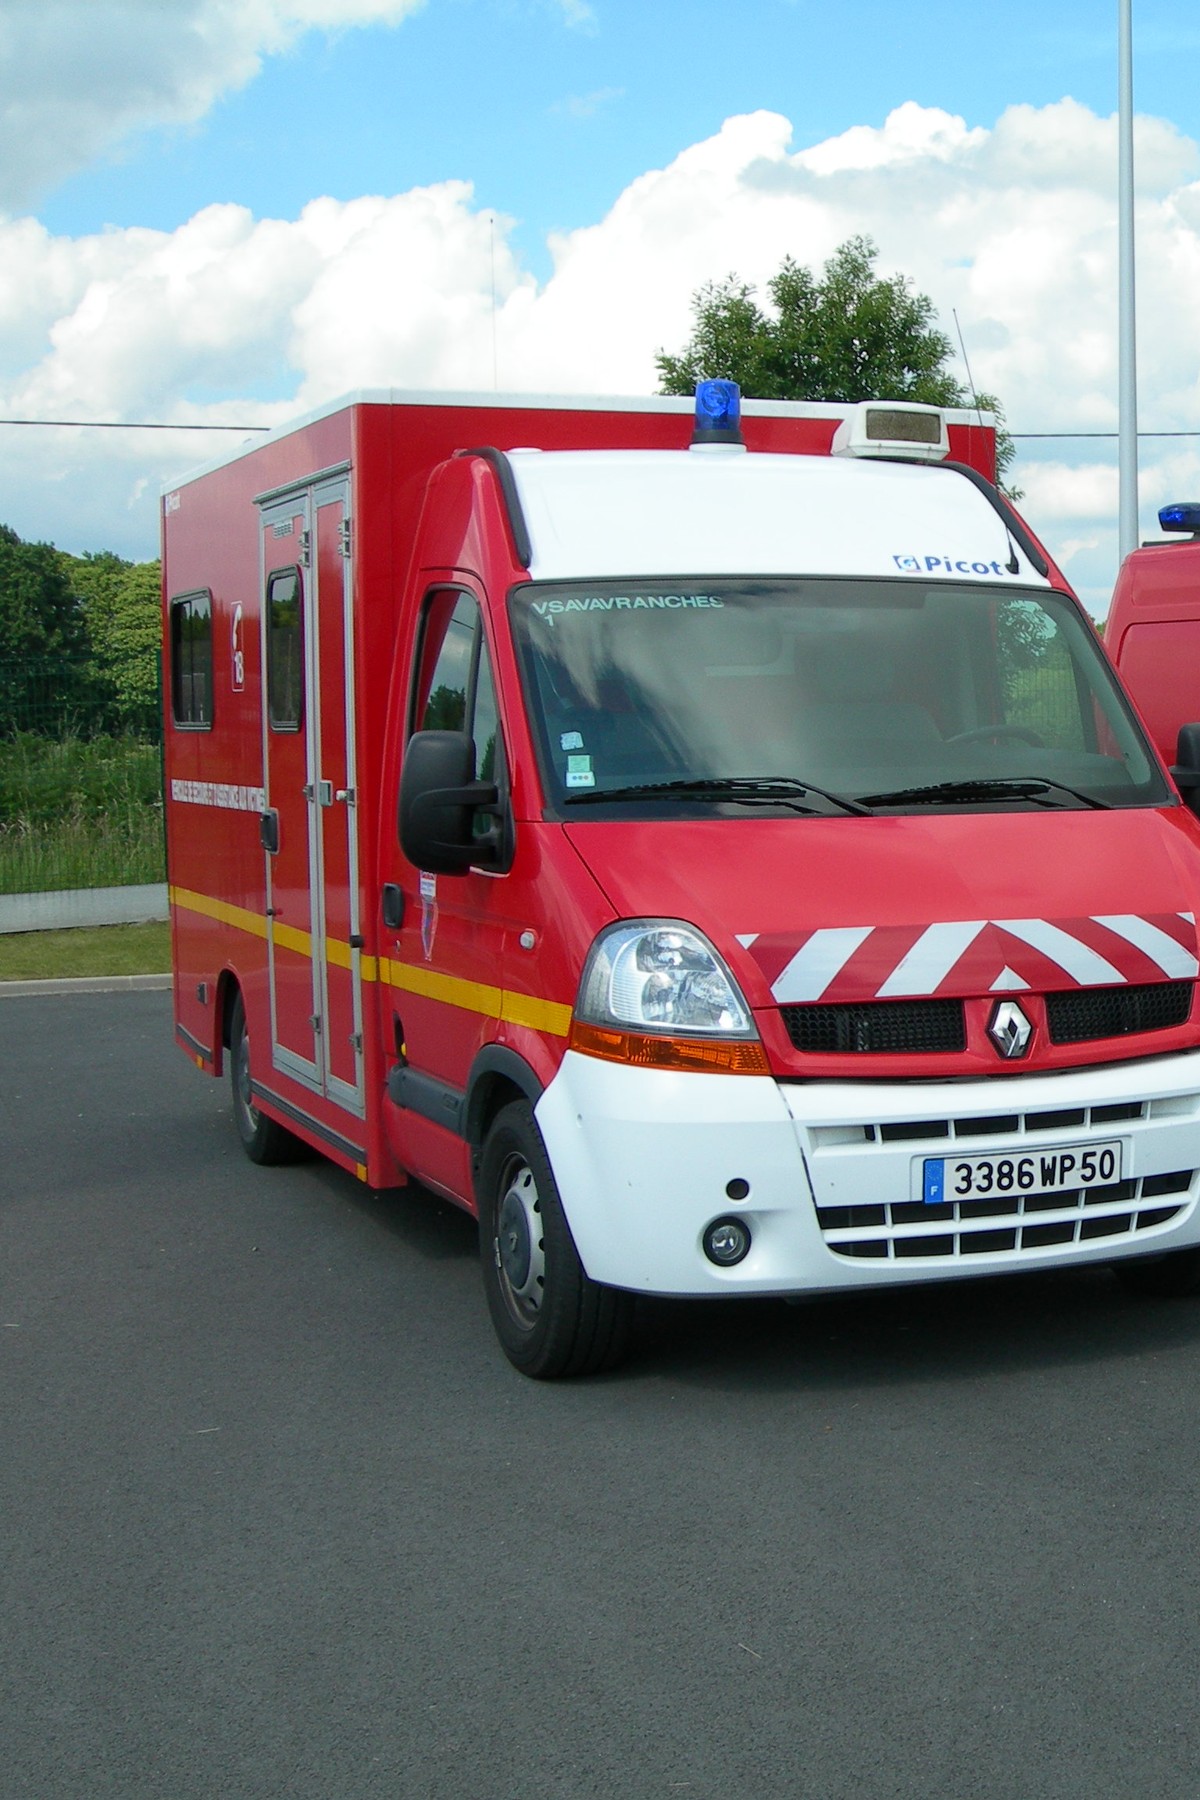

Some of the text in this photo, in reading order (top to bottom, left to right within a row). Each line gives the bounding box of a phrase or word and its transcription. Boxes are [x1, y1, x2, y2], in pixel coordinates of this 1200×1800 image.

[924, 556, 1004, 576] Picot
[544, 614, 554, 627] 1
[930, 1185, 939, 1197] F
